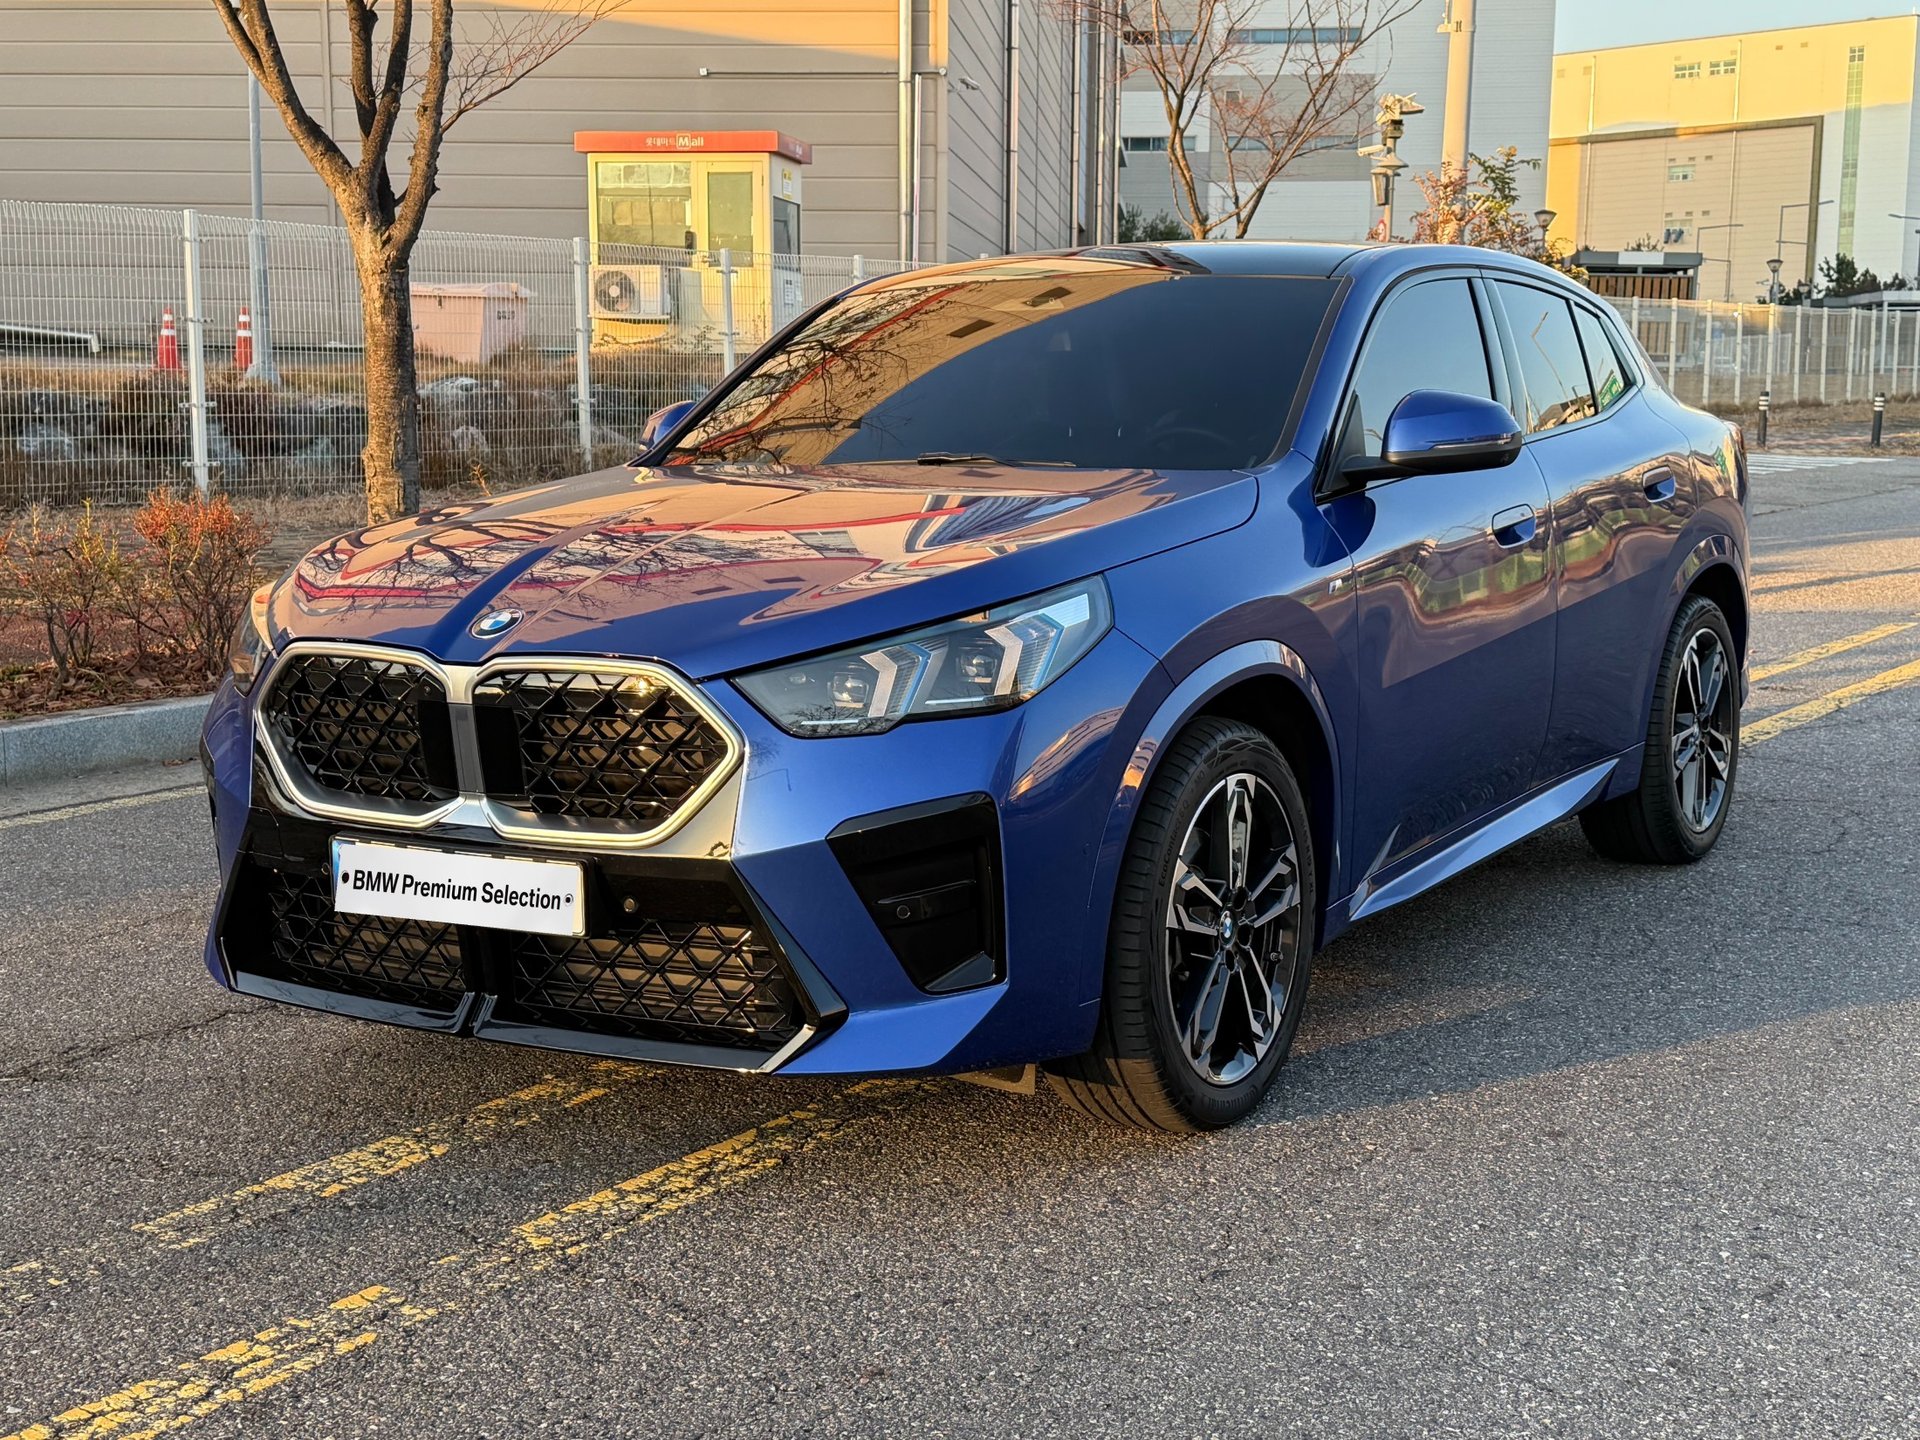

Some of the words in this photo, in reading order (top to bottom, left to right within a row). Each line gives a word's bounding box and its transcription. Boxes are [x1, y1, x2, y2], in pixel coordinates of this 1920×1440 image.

[677, 135, 705, 148] Mall
[353, 869, 399, 894] BMW
[402, 874, 477, 902] Premium
[481, 882, 561, 910] Selection
